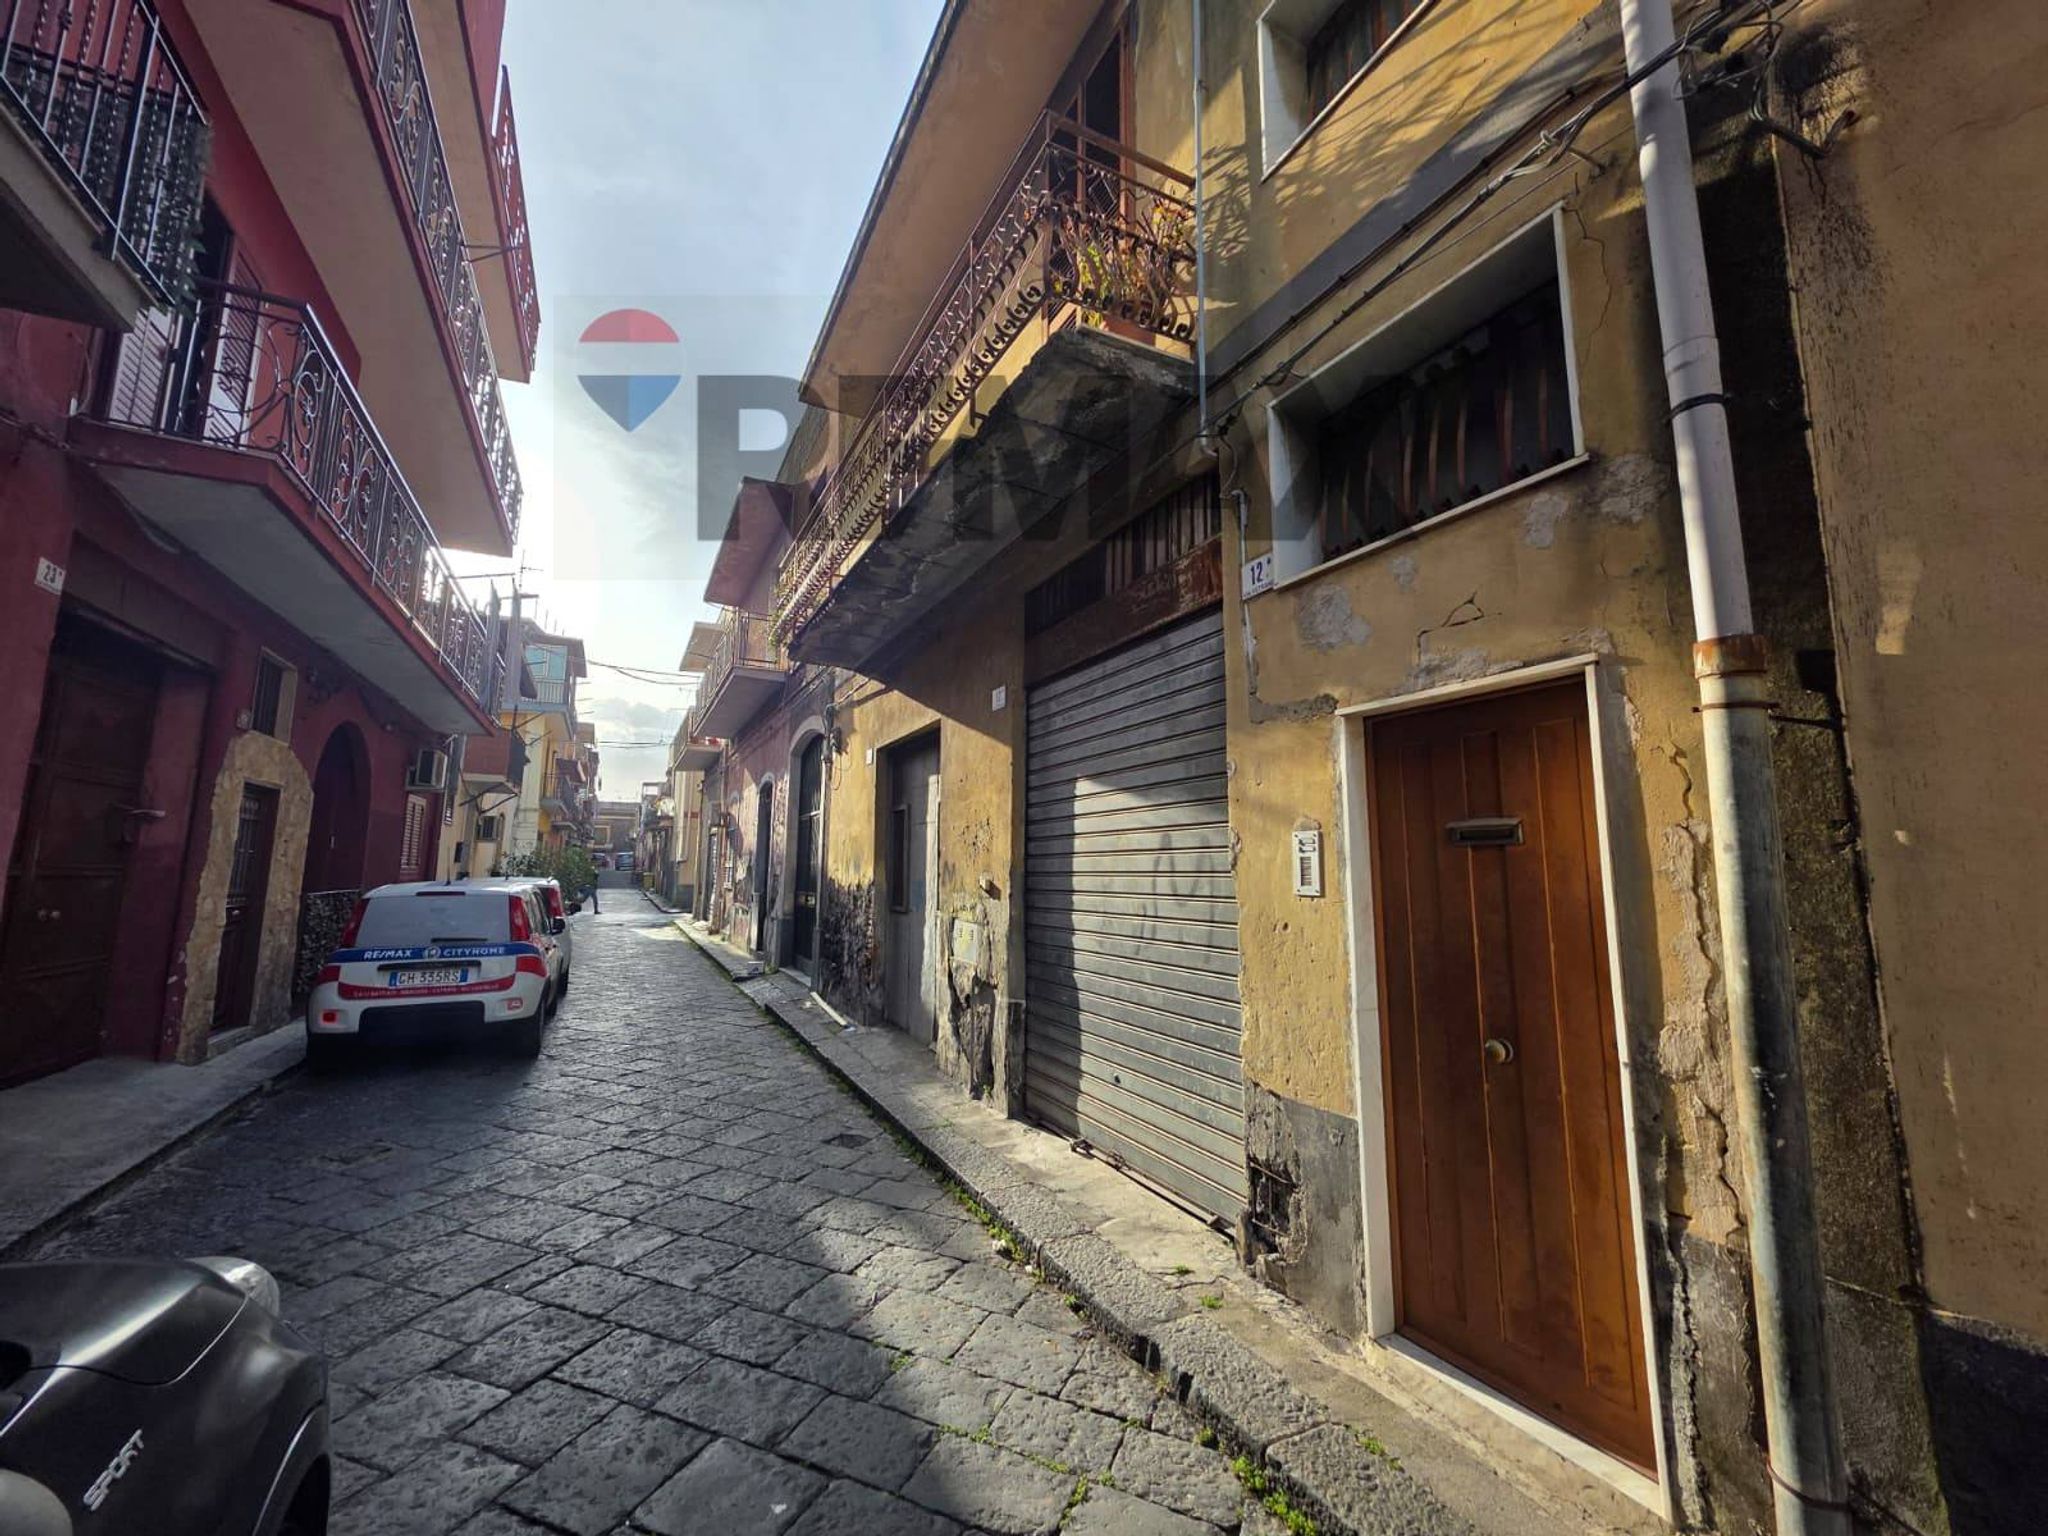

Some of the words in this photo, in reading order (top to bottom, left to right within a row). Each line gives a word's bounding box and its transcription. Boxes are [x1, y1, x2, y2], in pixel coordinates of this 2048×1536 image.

[363, 949, 413, 960] RE/MAX
[443, 946, 505, 958] CITYHOME
[84, 1429, 144, 1511] SPORT
